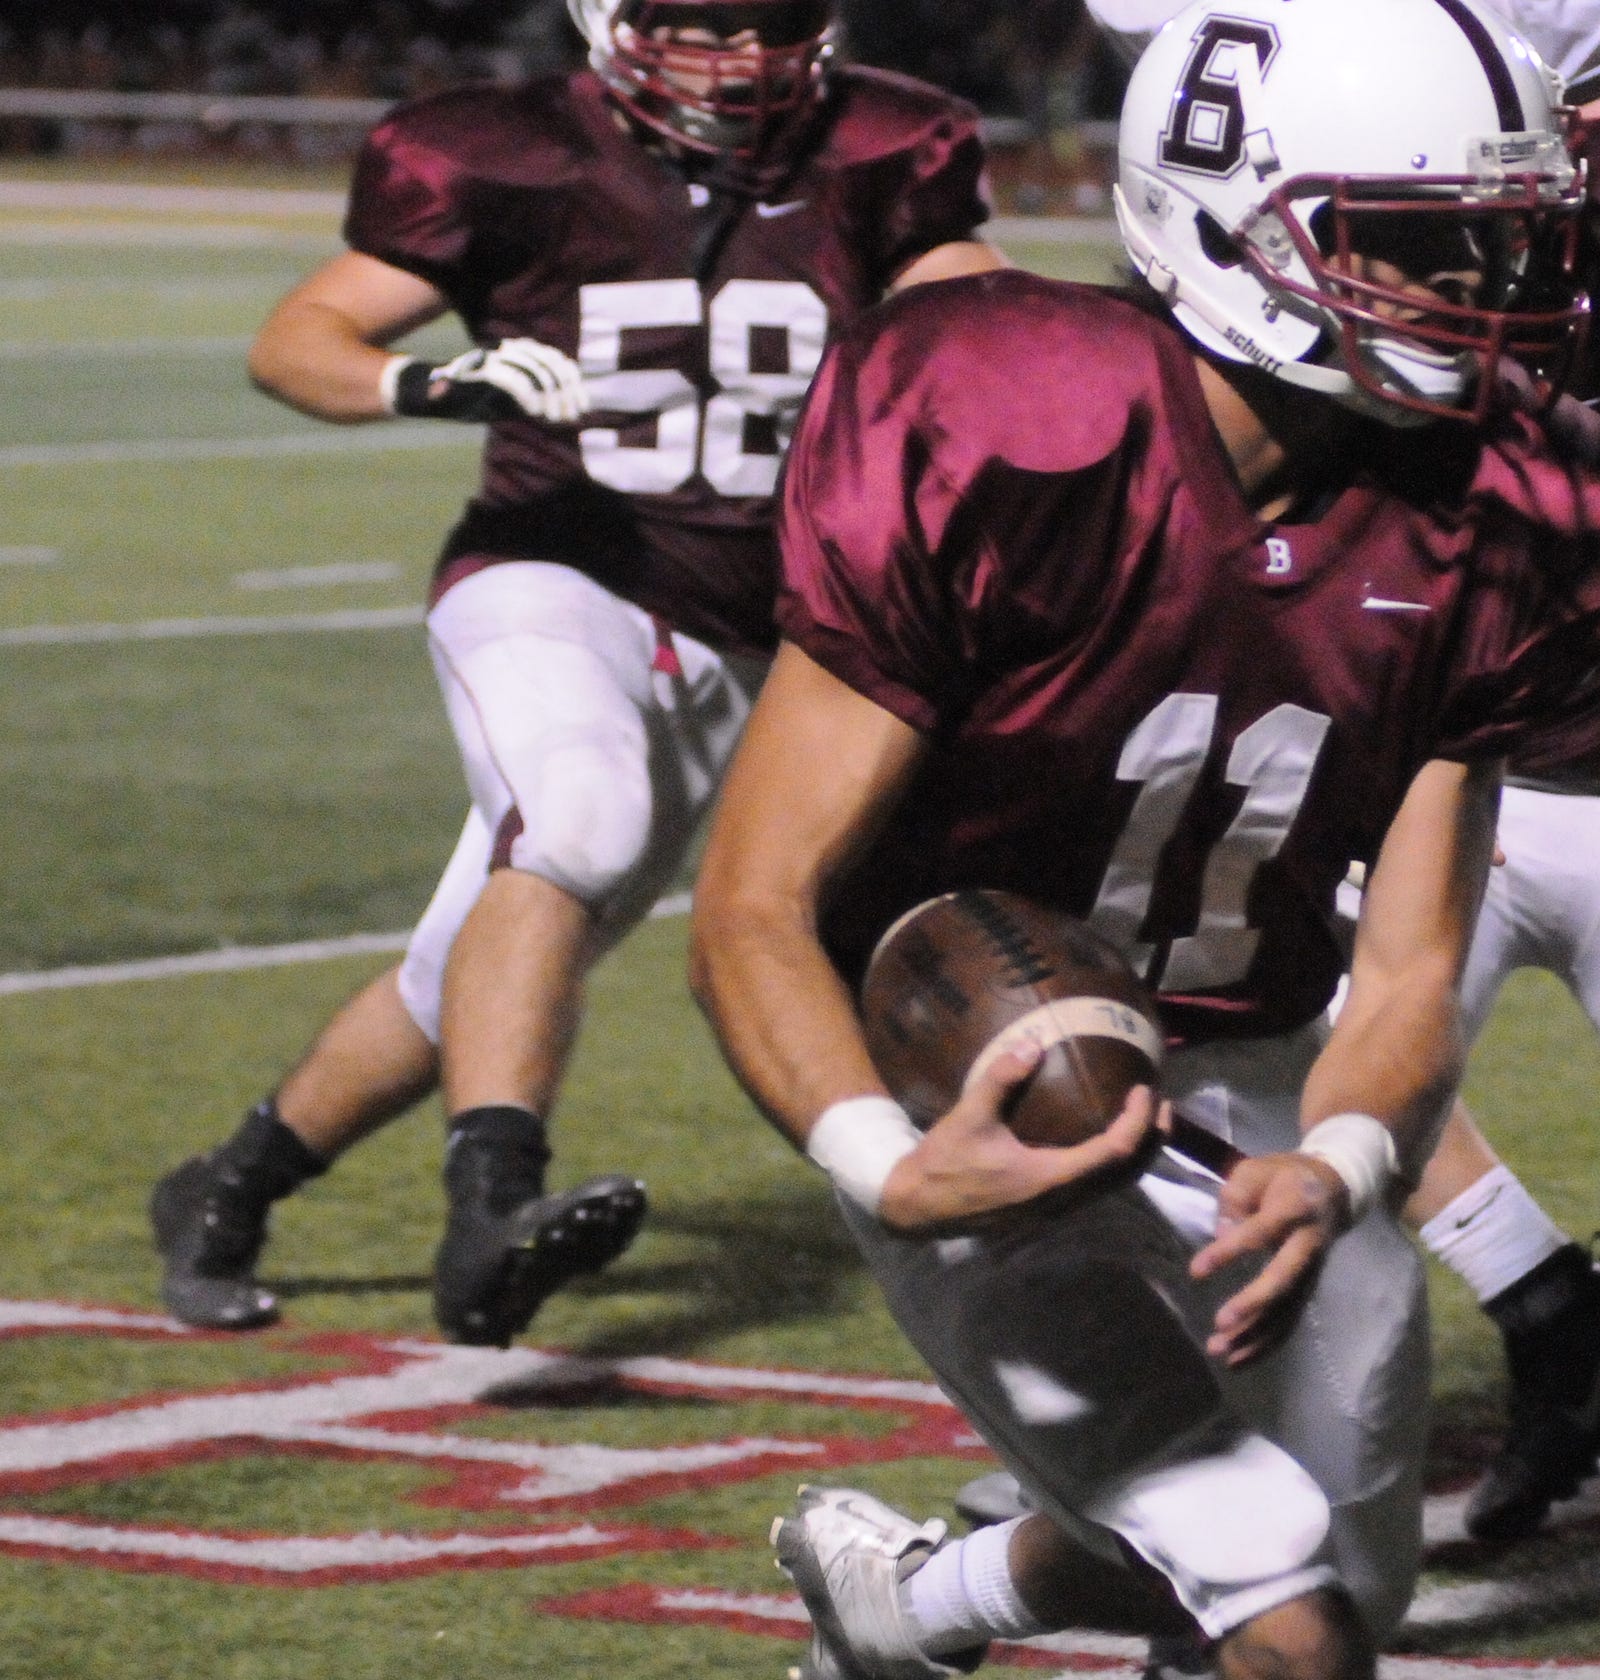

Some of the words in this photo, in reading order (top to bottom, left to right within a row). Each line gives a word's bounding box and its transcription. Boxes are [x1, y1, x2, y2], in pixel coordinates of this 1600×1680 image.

[578, 278, 828, 497] 58
[1265, 538, 1292, 574] B
[1088, 692, 1333, 991] 11
